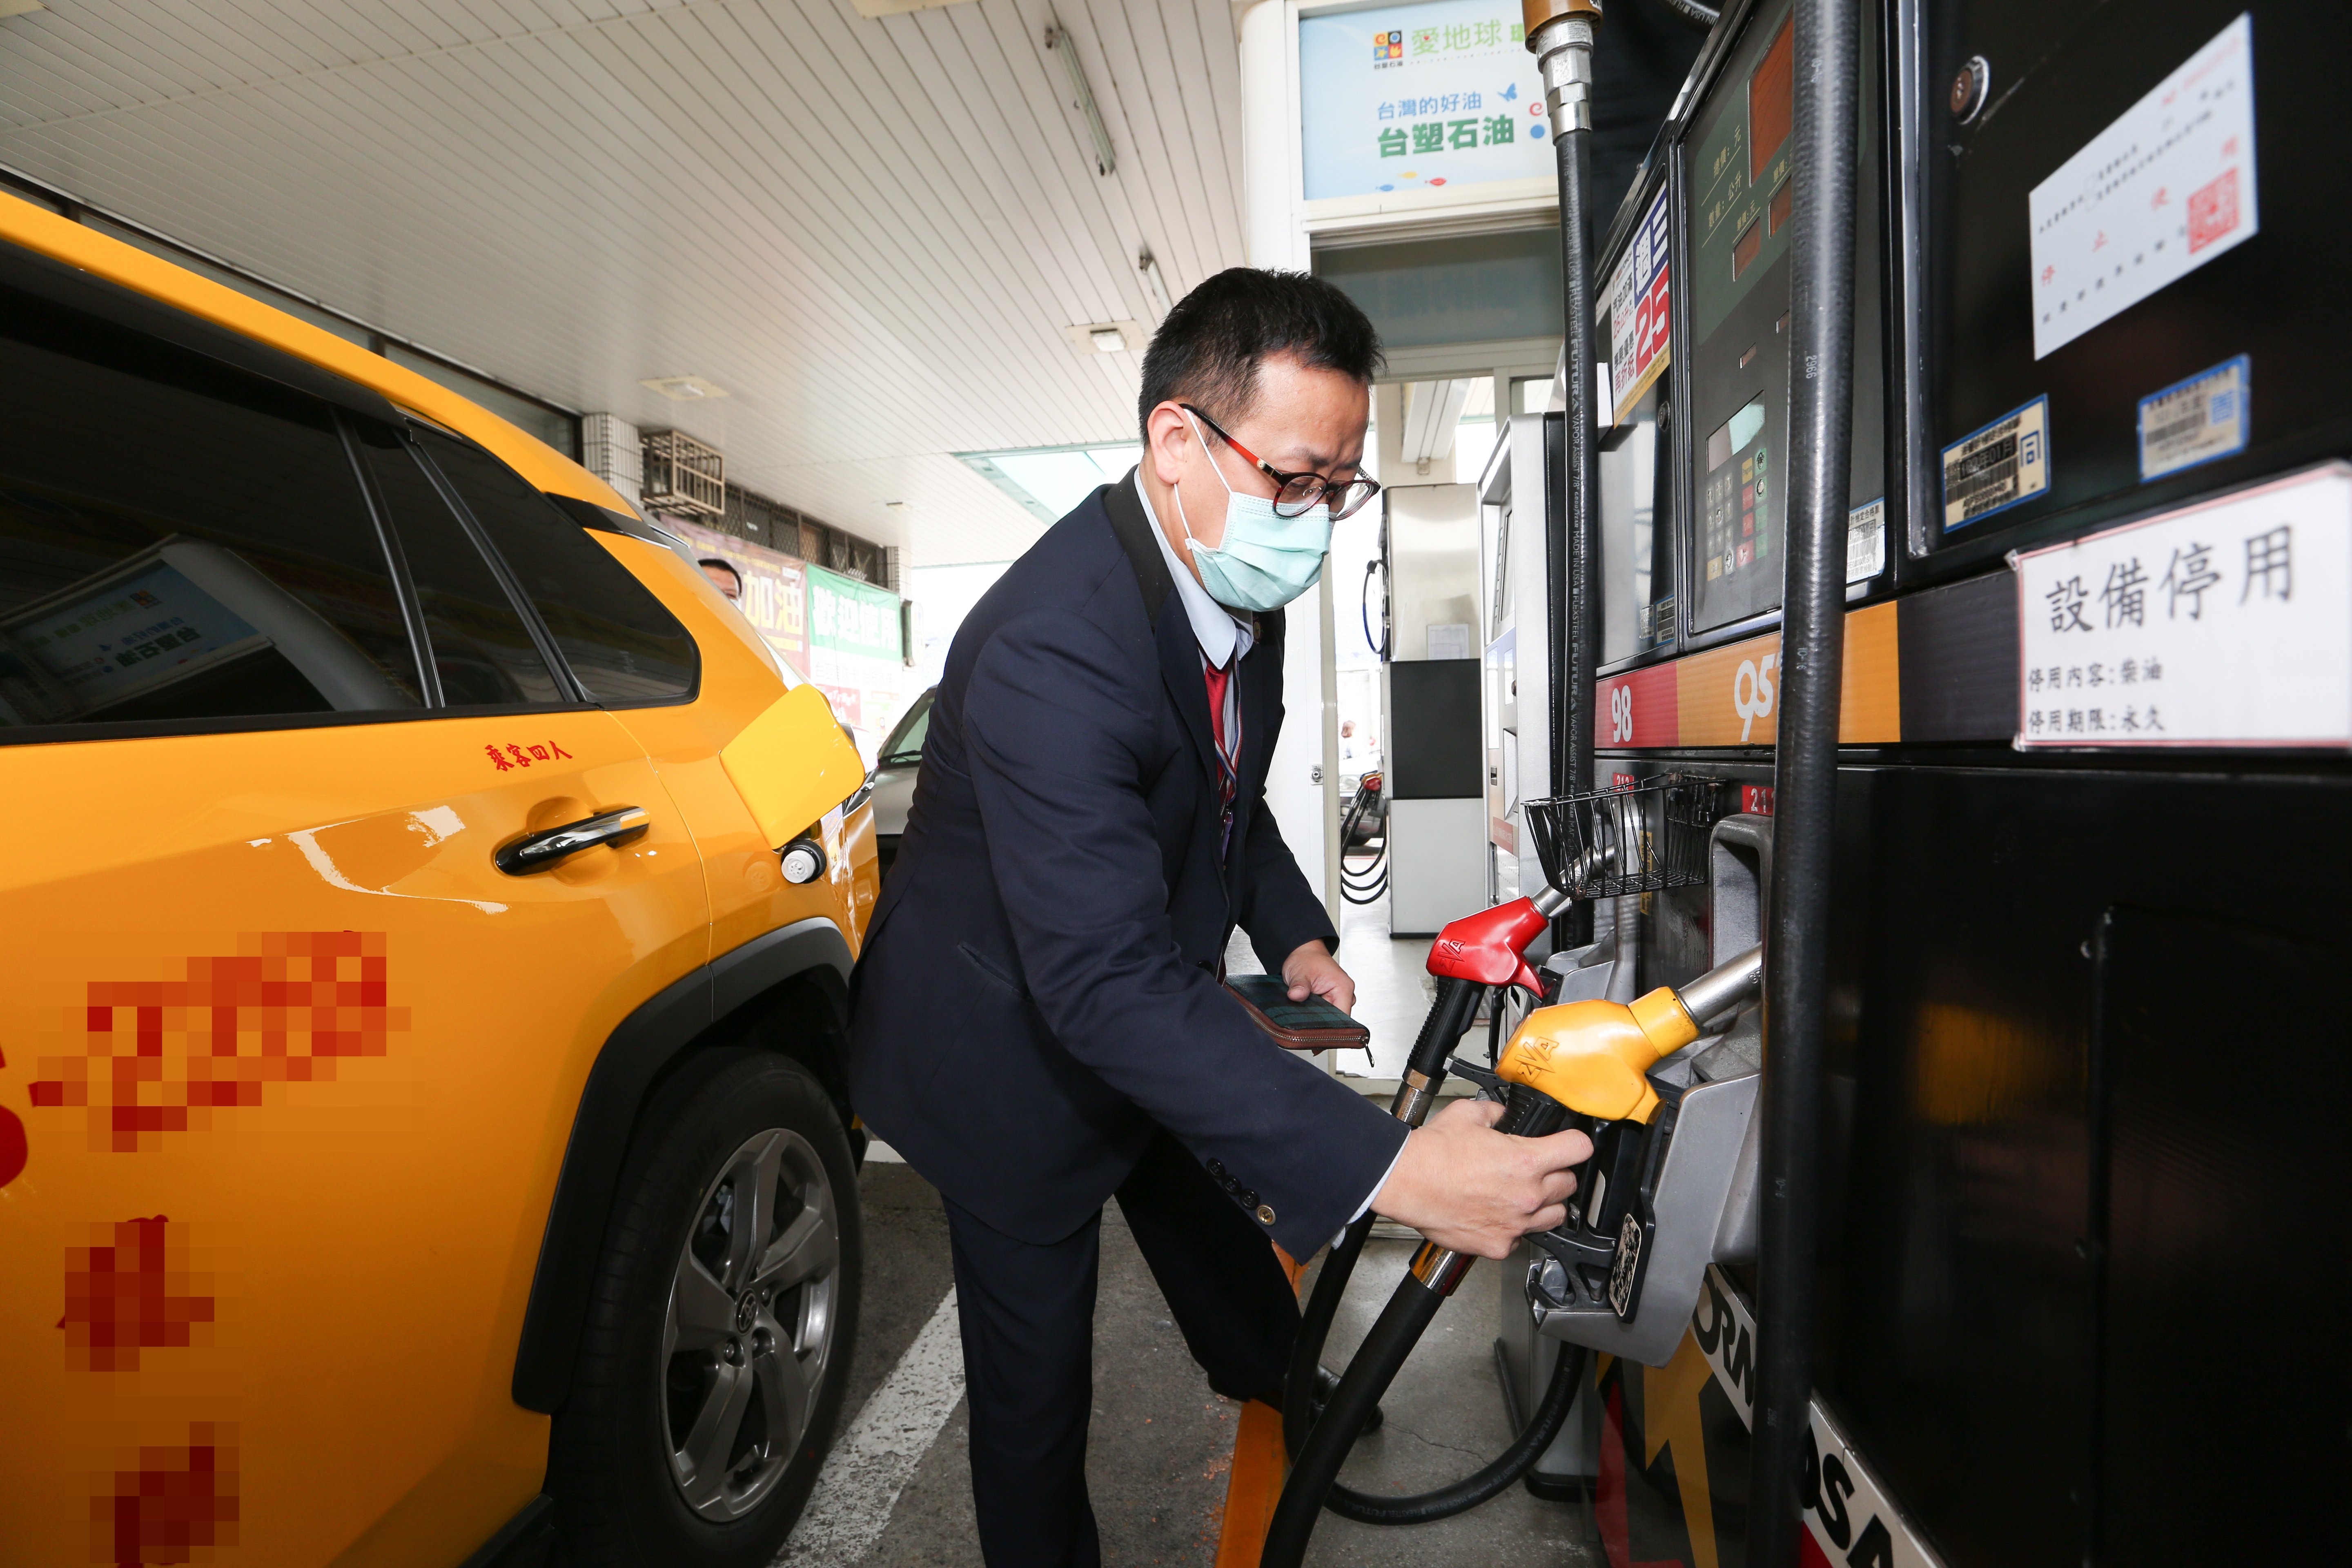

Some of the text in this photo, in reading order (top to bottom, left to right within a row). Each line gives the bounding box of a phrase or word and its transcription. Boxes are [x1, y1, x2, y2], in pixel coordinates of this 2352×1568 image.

[1690, 8, 1705, 22] USA
[1412, 19, 1502, 56] 愛地球
[1378, 91, 1482, 120] 台灣的好油
[1378, 114, 1515, 158] 台塑石油
[1568, 249, 1574, 260] IN
[1569, 289, 1578, 336] FLEXSTEEL
[1636, 263, 1670, 378] 25
[1571, 339, 1579, 412] FUTURA
[1805, 355, 1817, 379] 2966
[1573, 557, 1580, 567] IN
[2046, 525, 2291, 634] 設備停用
[743, 570, 803, 635] 加油
[813, 585, 898, 651] 歡迎使用
[1571, 642, 1579, 711] FUTURA
[2028, 657, 2164, 694] 停用內容：柴油
[1612, 685, 1633, 744] 98
[2028, 704, 2166, 735] 停用期限：永久
[484, 740, 572, 772] 乘客四人
[1751, 788, 1775, 813] 21
[1437, 938, 1466, 973] ZVA
[1514, 1036, 1560, 1084] ZVA
